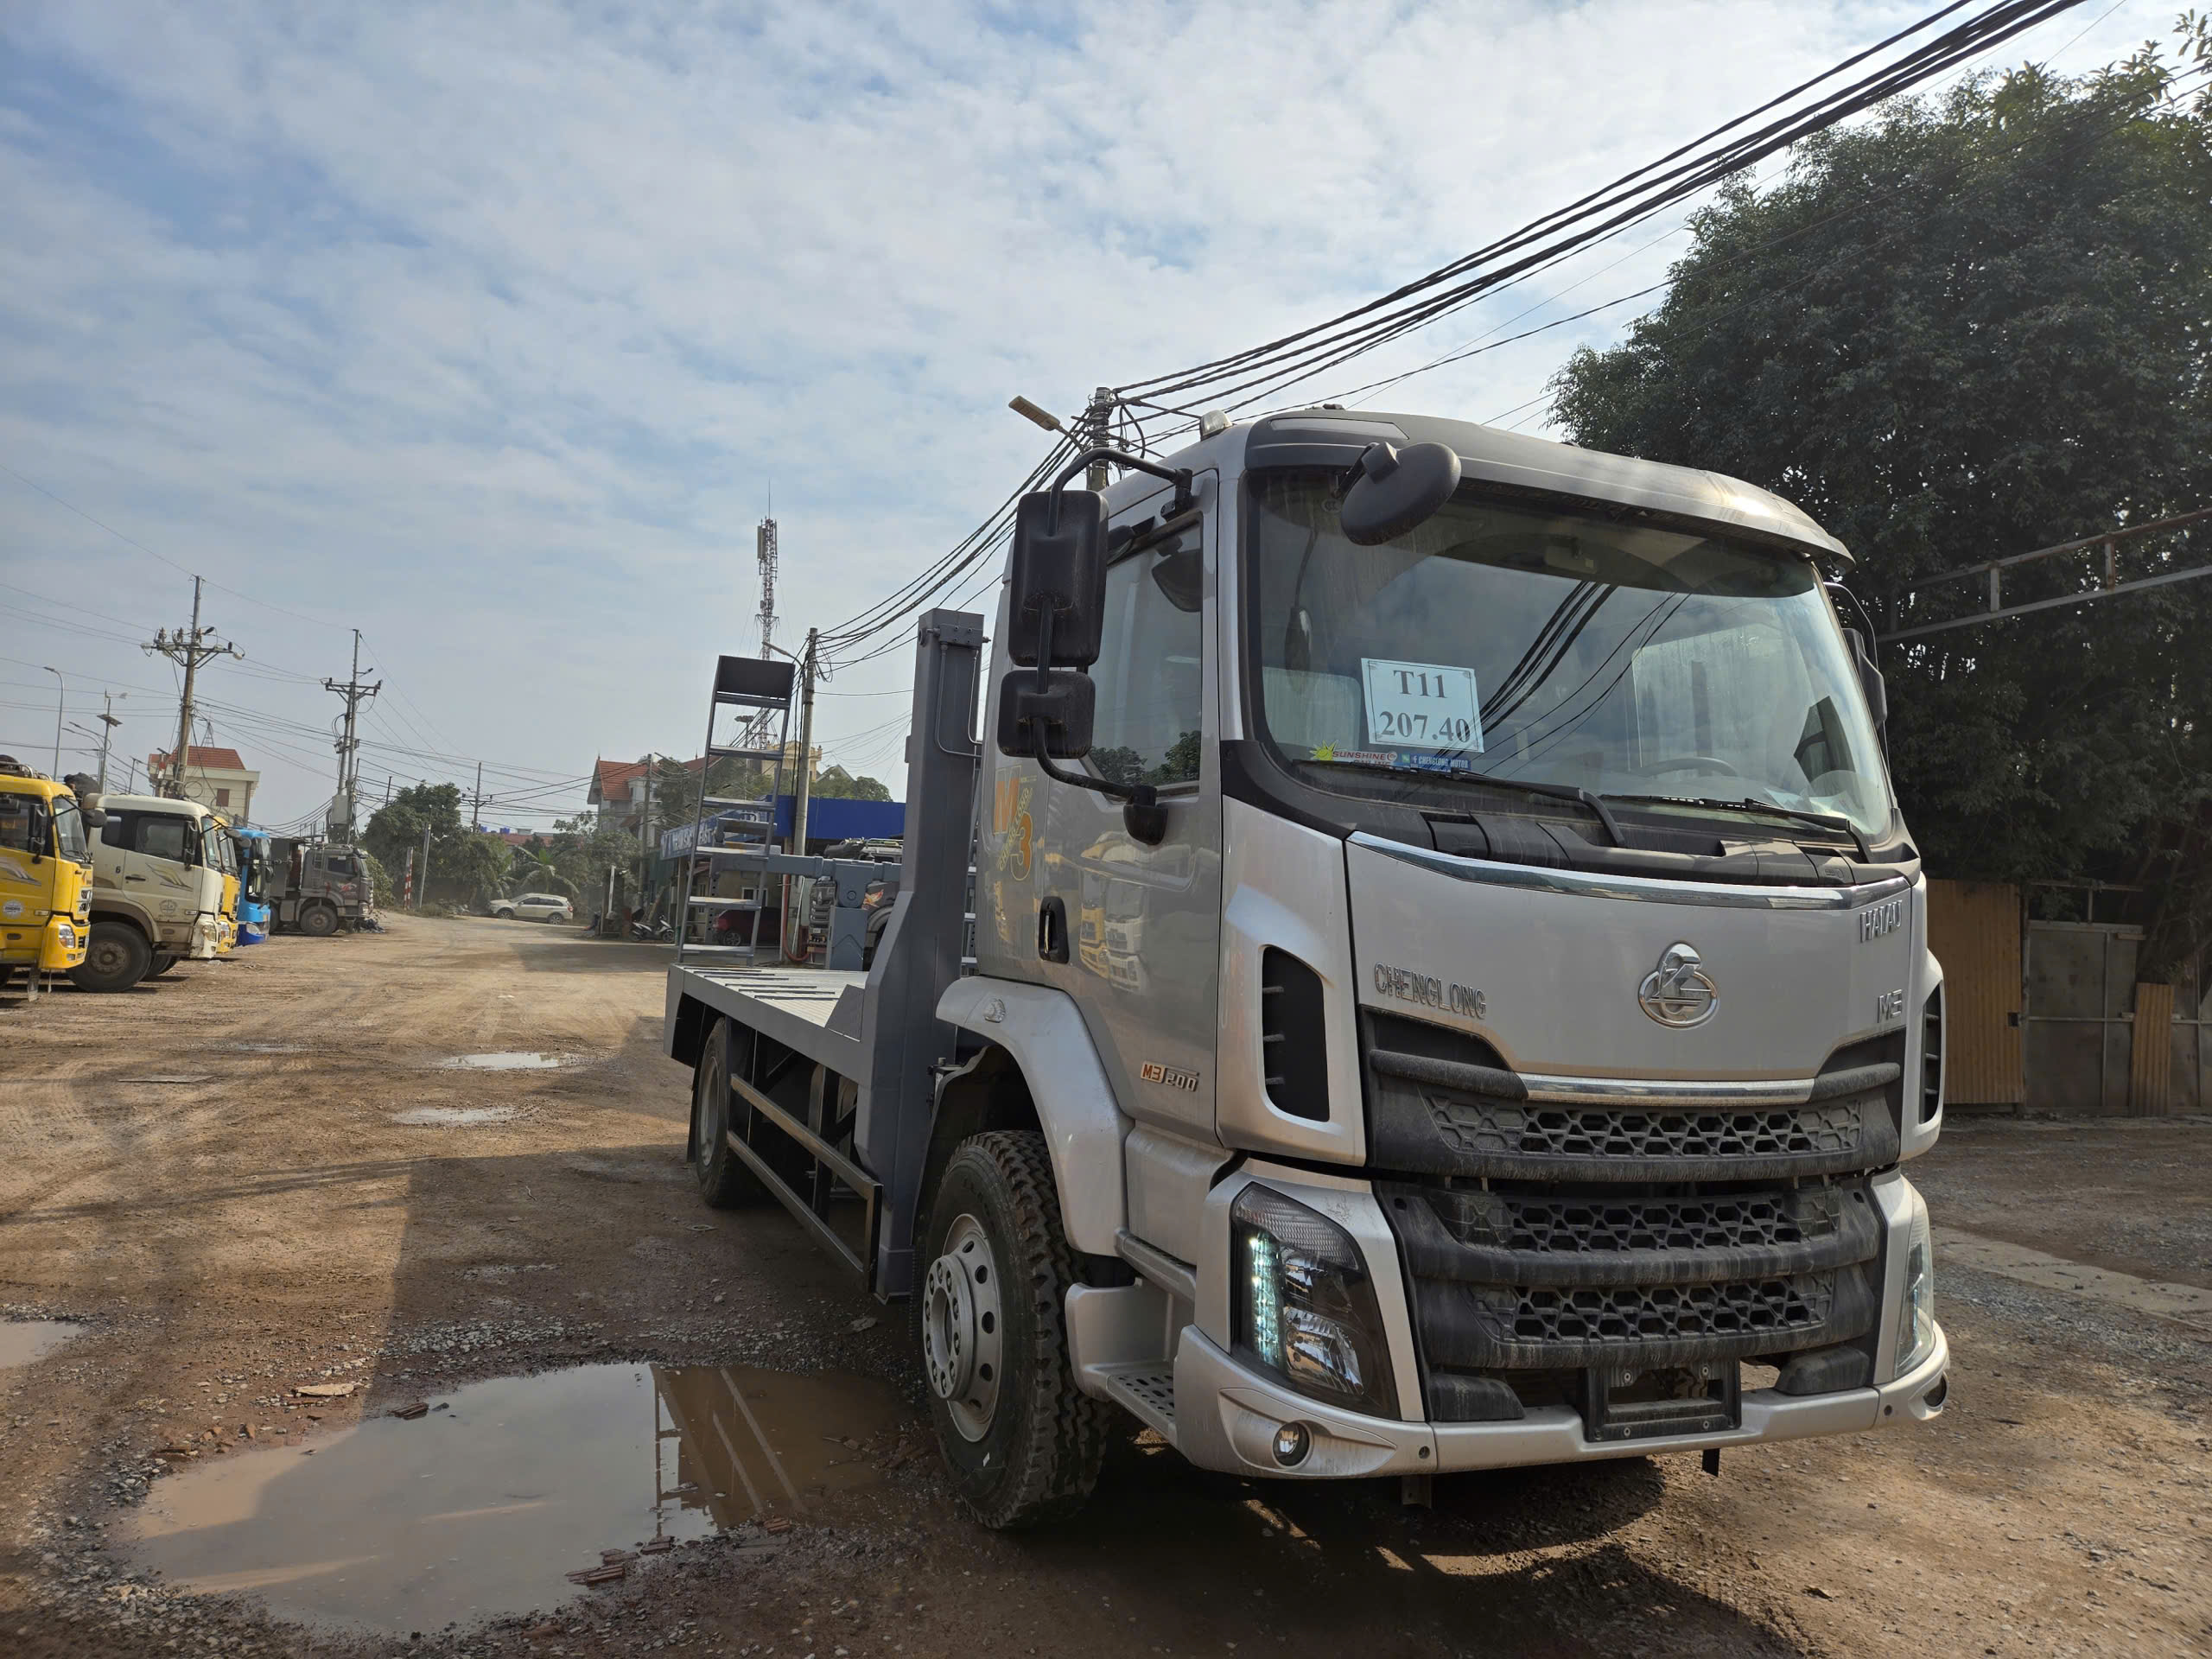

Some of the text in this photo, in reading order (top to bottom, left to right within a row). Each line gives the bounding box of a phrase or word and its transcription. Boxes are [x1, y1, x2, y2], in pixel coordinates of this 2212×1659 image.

[1393, 670, 1448, 699] T11
[1379, 711, 1471, 743] 207.40
[1332, 751, 1385, 760] SUNSHINE
[1374, 961, 1486, 1020] CHENGLONG
[1877, 988, 1902, 1023] M3
[1142, 1064, 1198, 1092] M3 200
